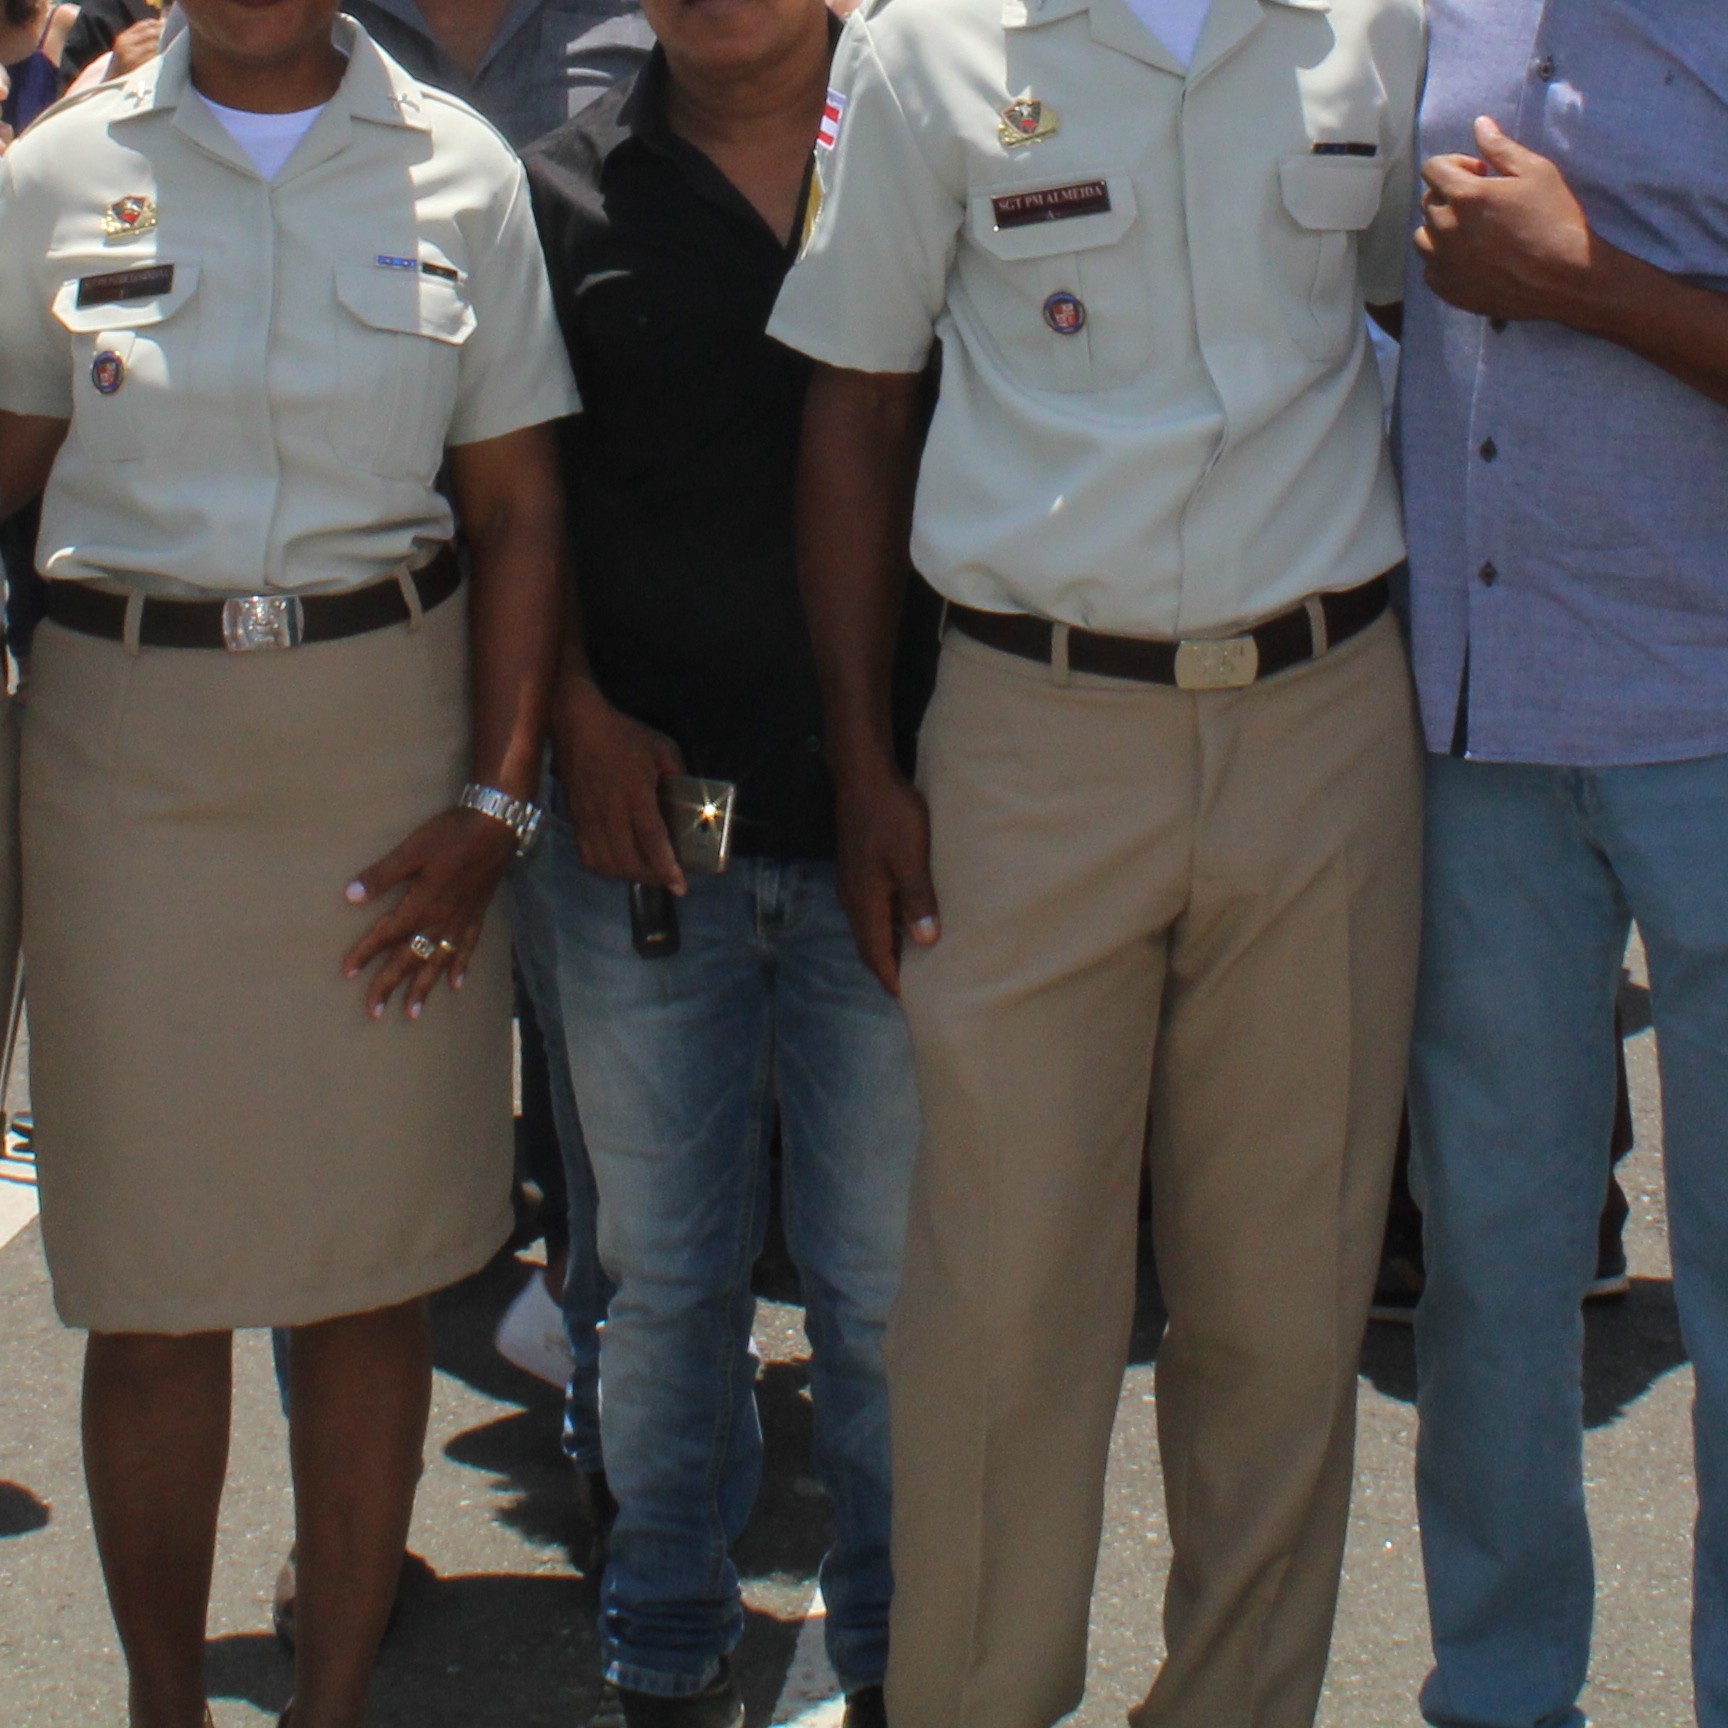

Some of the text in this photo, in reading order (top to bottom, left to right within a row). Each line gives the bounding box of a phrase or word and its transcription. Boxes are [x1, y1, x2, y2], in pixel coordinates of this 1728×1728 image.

[998, 185, 1103, 210] SGT PM ALMEIDA
